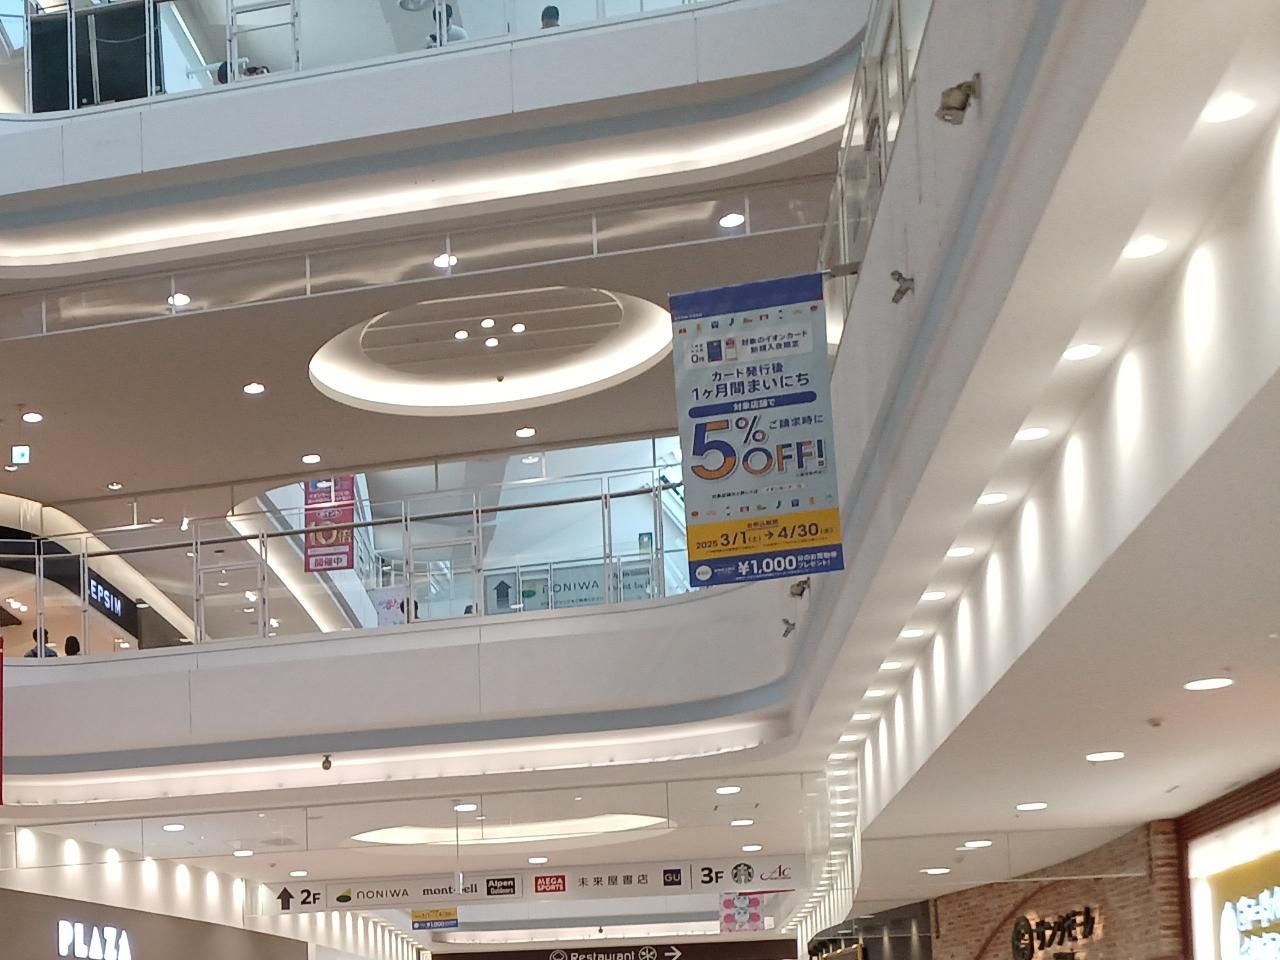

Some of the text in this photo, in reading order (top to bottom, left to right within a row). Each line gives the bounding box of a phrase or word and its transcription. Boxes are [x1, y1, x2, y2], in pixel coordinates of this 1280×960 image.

[741, 439, 825, 476] OFF!
[720, 531, 747, 546] 3/1
[777, 523, 819, 540] 4/30
[738, 555, 797, 576] ¥1,000
[89, 579, 122, 616] EPSIM
[487, 879, 514, 888] Alpen
[536, 877, 564, 885] MEGA
[700, 866, 724, 884] 3F
[536, 883, 564, 892] SPORTS
[300, 888, 321, 906] 2F
